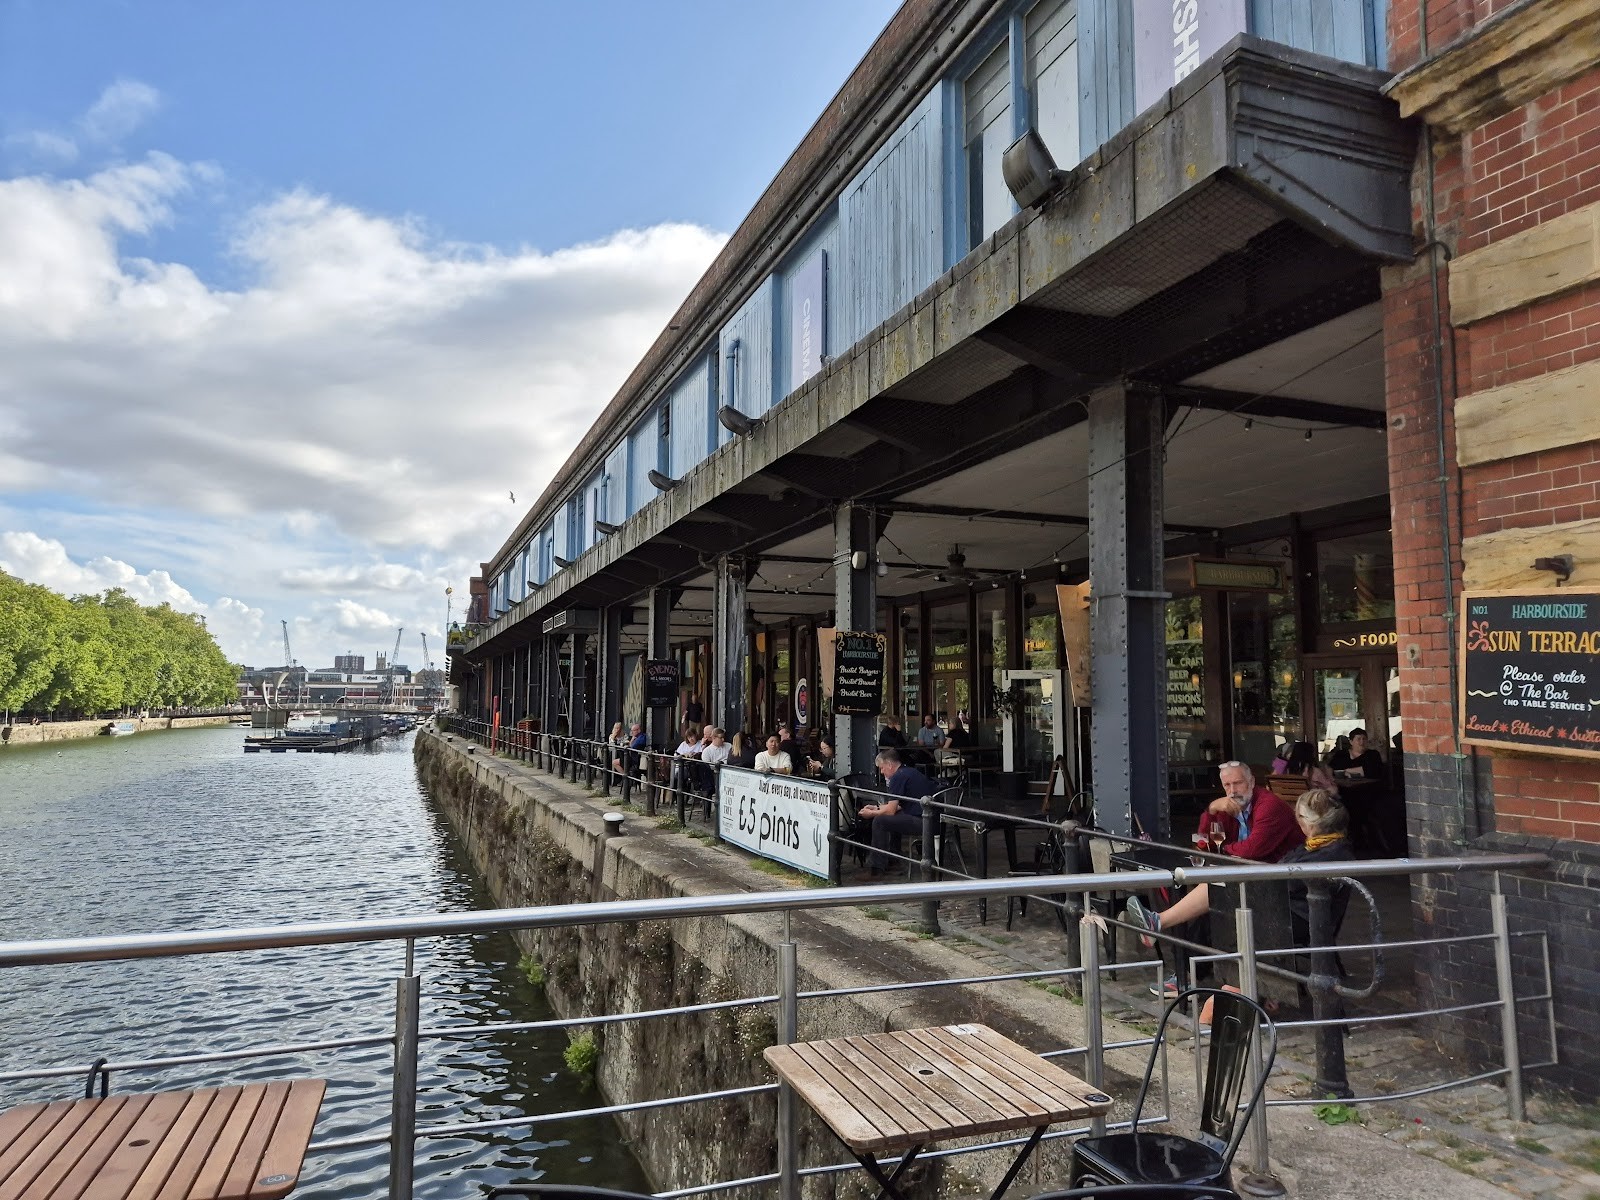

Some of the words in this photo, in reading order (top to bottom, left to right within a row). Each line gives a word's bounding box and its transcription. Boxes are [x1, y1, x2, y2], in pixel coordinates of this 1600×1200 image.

[1172, 0, 1200, 86] SHE
[1512, 604, 1587, 618] HARBOURSIDE
[1360, 632, 1398, 646] FOOD
[1488, 630, 1521, 652] SUN
[1528, 630, 1600, 654] TERRAC
[1503, 664, 1544, 682] Please
[1552, 670, 1586, 684] order
[1518, 684, 1542, 698] The
[1544, 683, 1570, 700] Bar
[1522, 700, 1547, 709] TABLE
[1466, 715, 1499, 732] Local
[1511, 720, 1553, 738] Ethical
[1568, 726, 1600, 742] Susta
[739, 795, 756, 835] £5
[759, 806, 800, 850] pints
